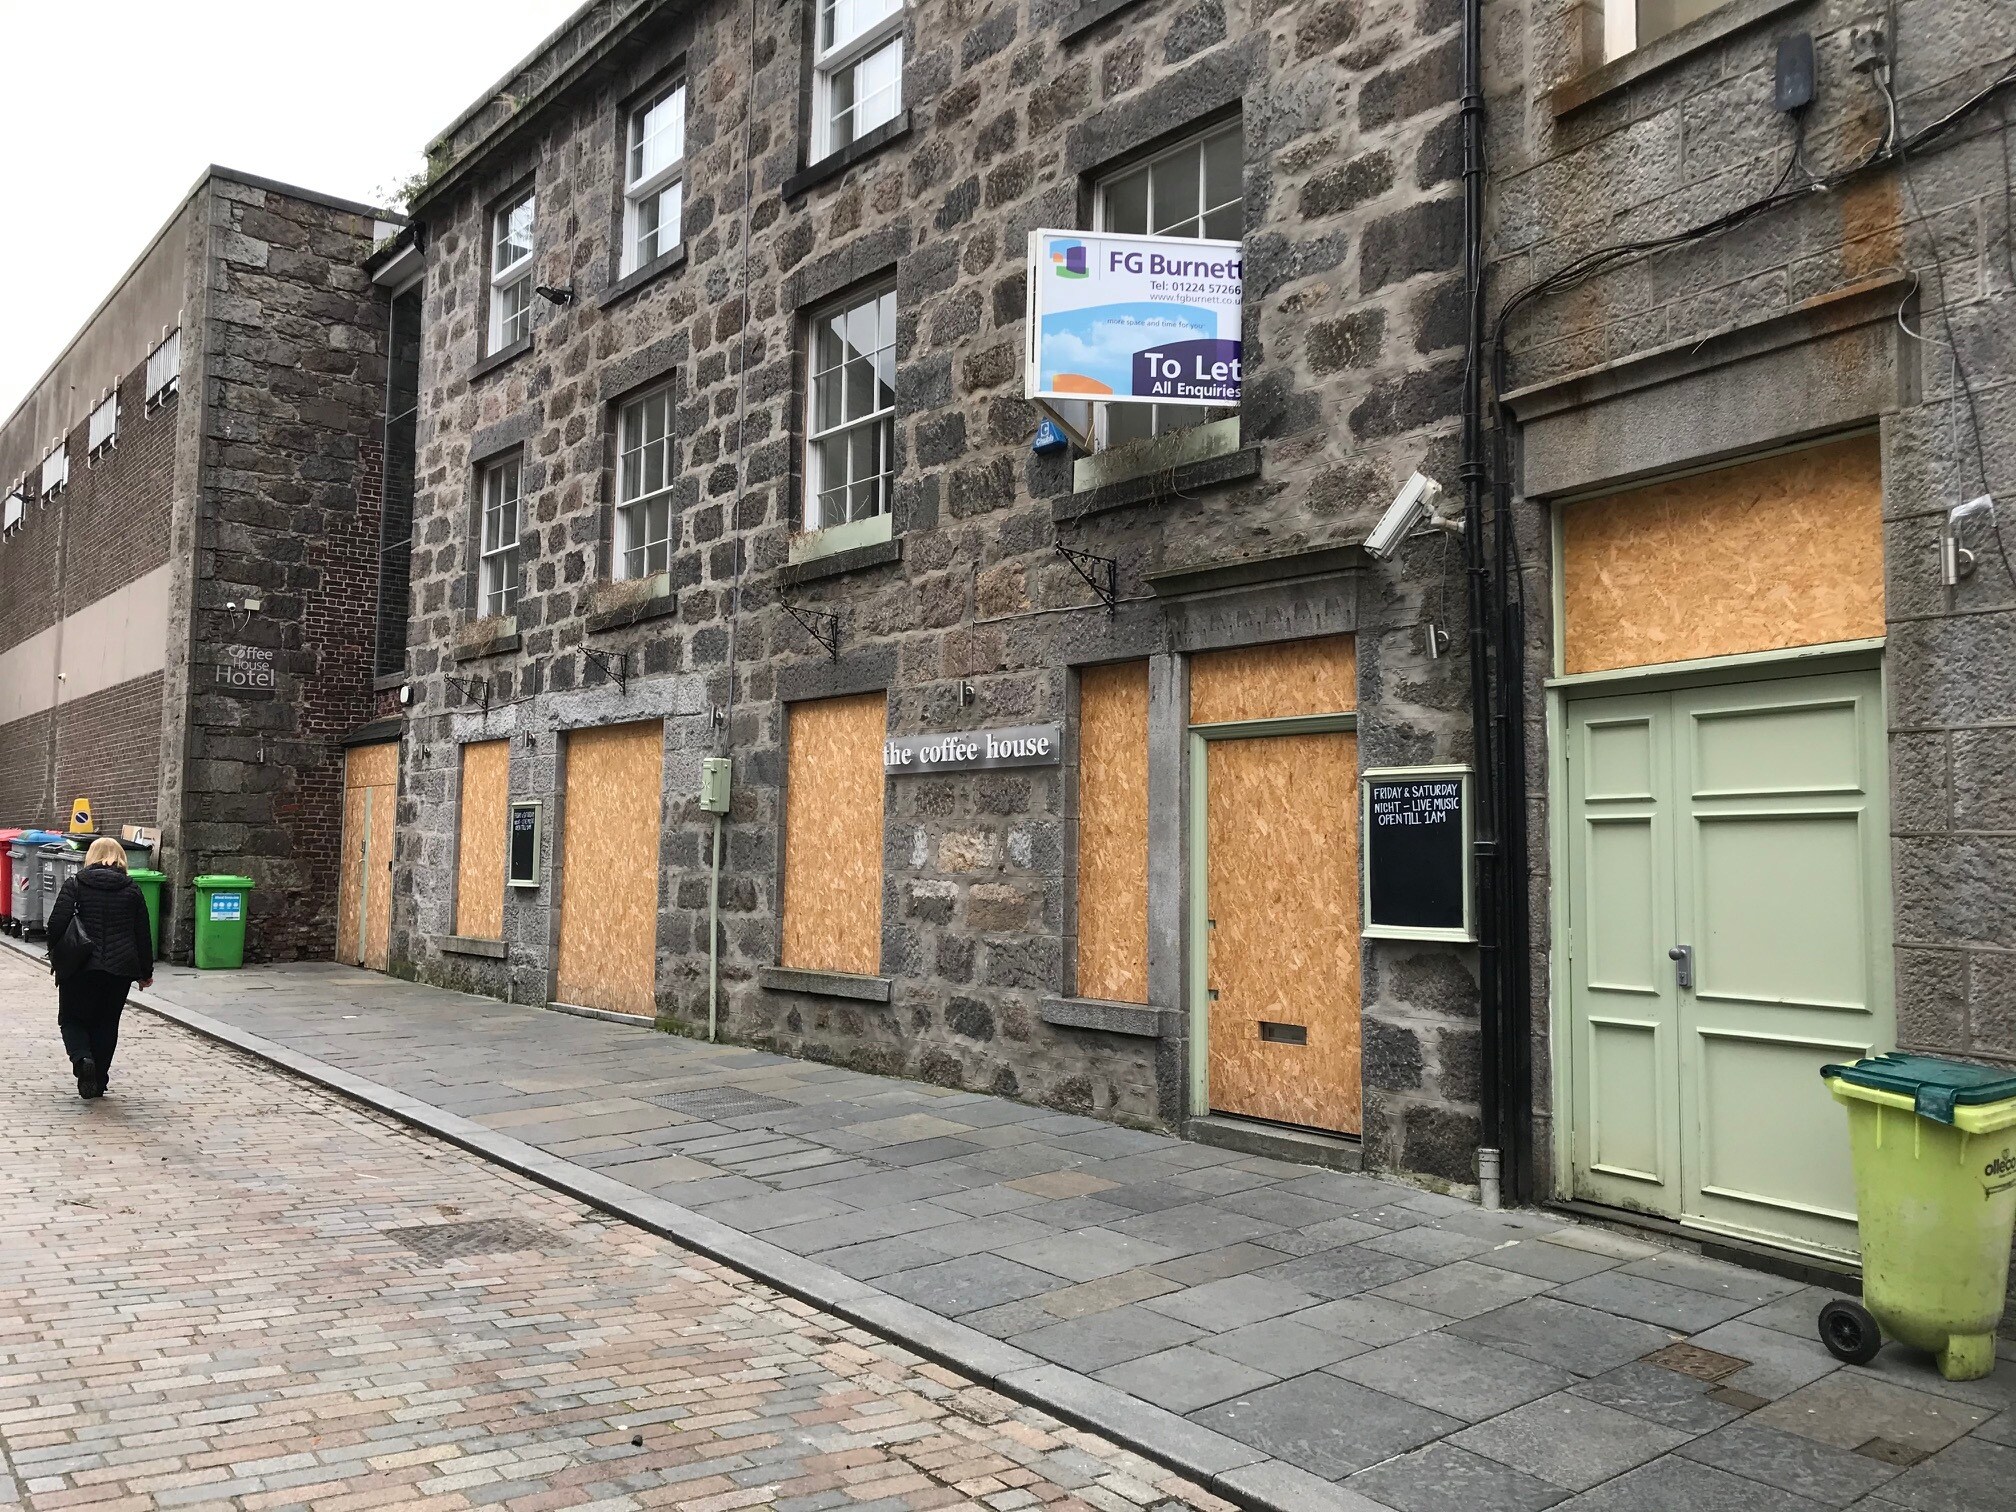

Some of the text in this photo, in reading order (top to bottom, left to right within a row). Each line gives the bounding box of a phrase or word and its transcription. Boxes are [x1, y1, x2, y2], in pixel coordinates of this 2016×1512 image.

[1110, 251, 1242, 279] FG Burnett
[1150, 281, 1169, 291] Tel:
[1172, 282, 1205, 293] 01224
[1161, 320, 1177, 328] time
[1144, 352, 1241, 381] To Let
[1152, 381, 1241, 399] All Enquiries
[228, 644, 273, 660] Coffee
[233, 657, 269, 671] House
[216, 665, 274, 686] Hotel
[883, 733, 1050, 766] the coffee house
[1374, 784, 1458, 800] FRIDAY & SATURDAY
[1412, 799, 1432, 811] LIVE
[1433, 797, 1460, 810] MUSIC
[1378, 811, 1446, 825] OPEN TILL 1AM
